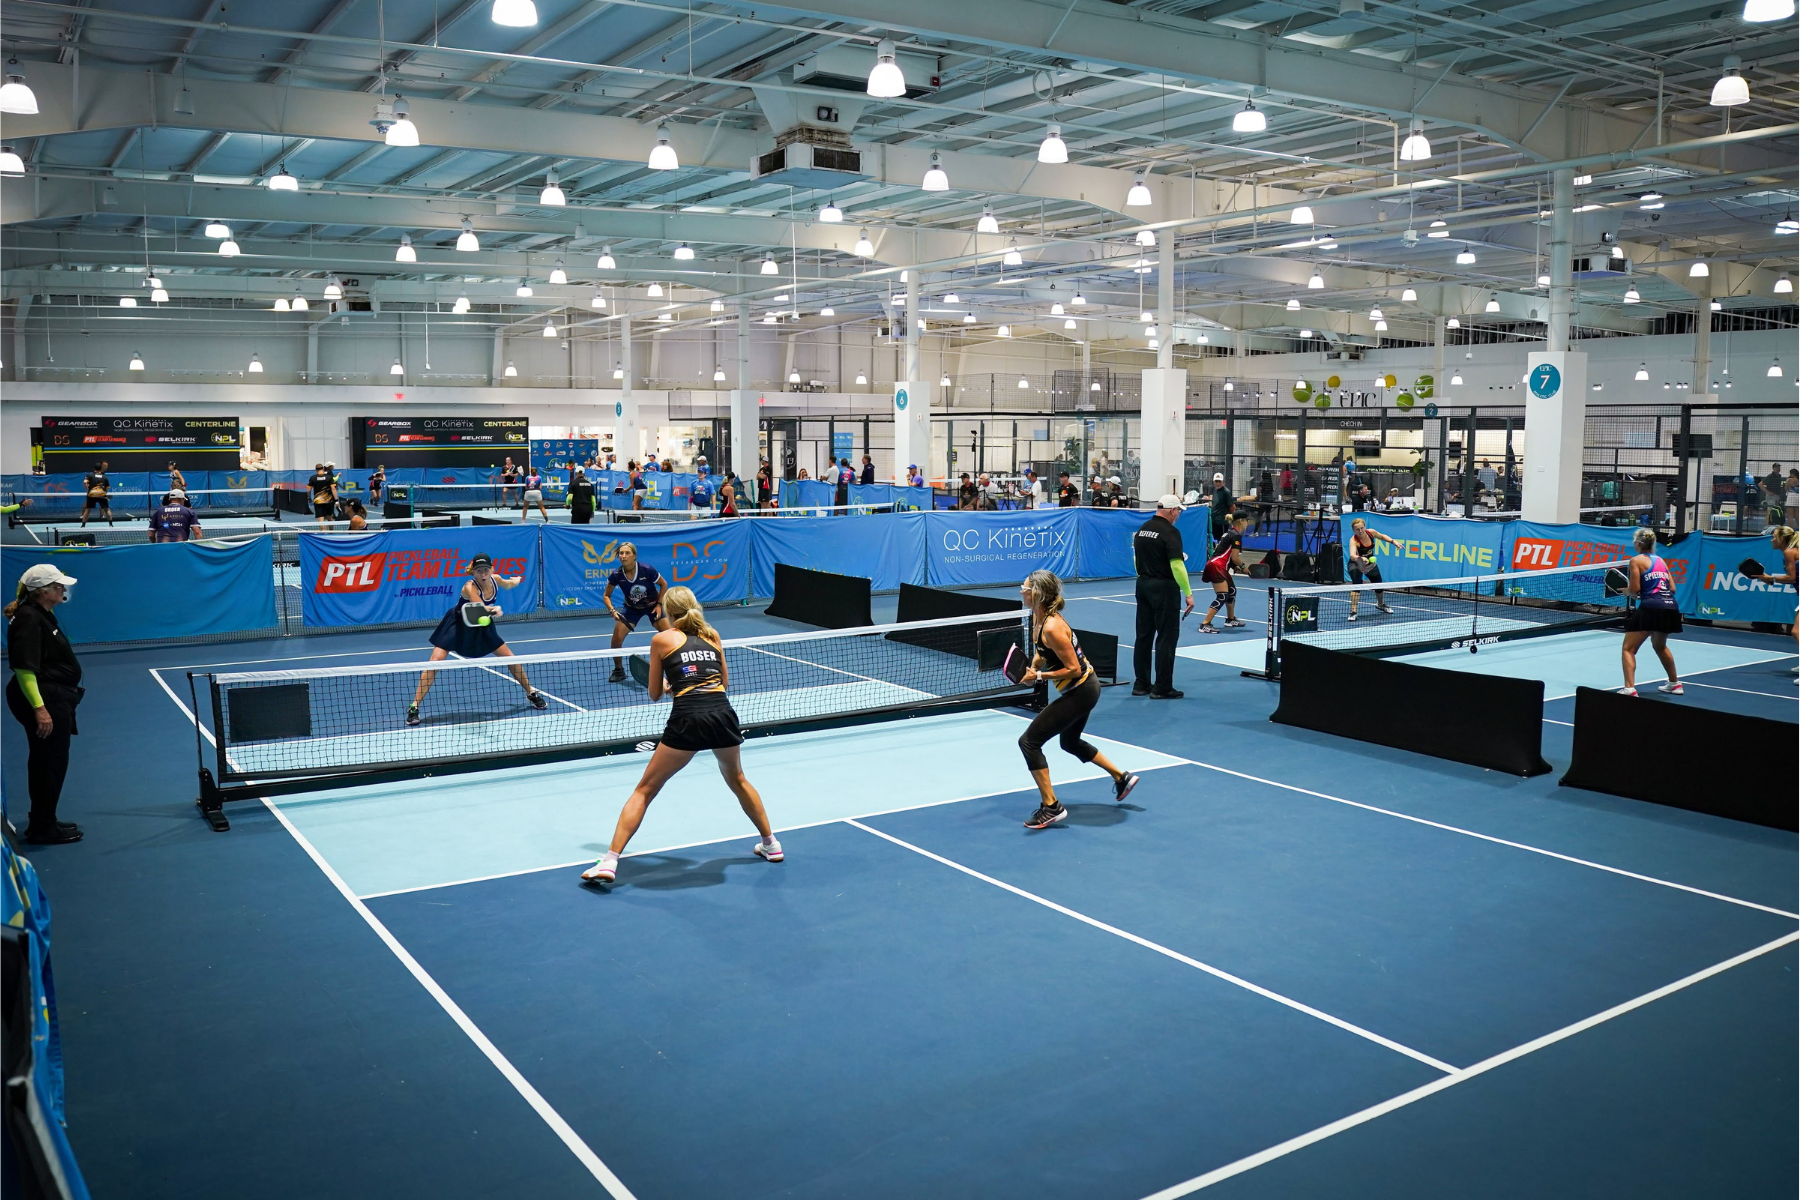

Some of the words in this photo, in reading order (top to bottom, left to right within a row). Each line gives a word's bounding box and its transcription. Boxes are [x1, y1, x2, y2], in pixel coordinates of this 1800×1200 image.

[1540, 374, 1551, 390] 7
[899, 395, 905, 405] 6
[113, 419, 131, 429] QC
[134, 418, 174, 428] Kinetix
[184, 420, 237, 428] CENTERLINE
[423, 419, 440, 429] QC
[441, 418, 475, 429] Kinetix
[483, 420, 528, 428] CENTERLINE
[53, 434, 71, 446] DS
[84, 435, 97, 443] PTL
[214, 434, 237, 443] NPL
[374, 433, 389, 444] DS
[507, 433, 527, 442] NPL
[336, 481, 366, 492] NPL
[546, 475, 566, 491] NPL
[943, 528, 980, 552] QC
[988, 525, 1067, 550] Kinetix
[1138, 530, 1160, 540] REFEREE
[1373, 538, 1493, 568] NTERLINE
[1564, 539, 1627, 555] PICKLEBALL
[388, 547, 460, 562] PICKLEBALL
[672, 539, 728, 582] DS
[944, 553, 1005, 564] NON-SURGICAL
[1006, 549, 1066, 561] REGENERATION
[1514, 542, 1554, 567] PTL
[1562, 550, 1607, 567] TEAM
[323, 560, 376, 588] PTL
[386, 560, 442, 582] TEAM
[442, 556, 528, 578] LEUES
[1571, 573, 1606, 585] PICKLEB
[399, 584, 454, 598] PICKLEBALL
[559, 597, 584, 606] NPL
[1291, 609, 1317, 622] NPL
[1701, 605, 1726, 616] NPL
[1267, 597, 1275, 639] SELKIRK
[1461, 635, 1500, 648] SELKIRK
[680, 650, 718, 664] BOSER
